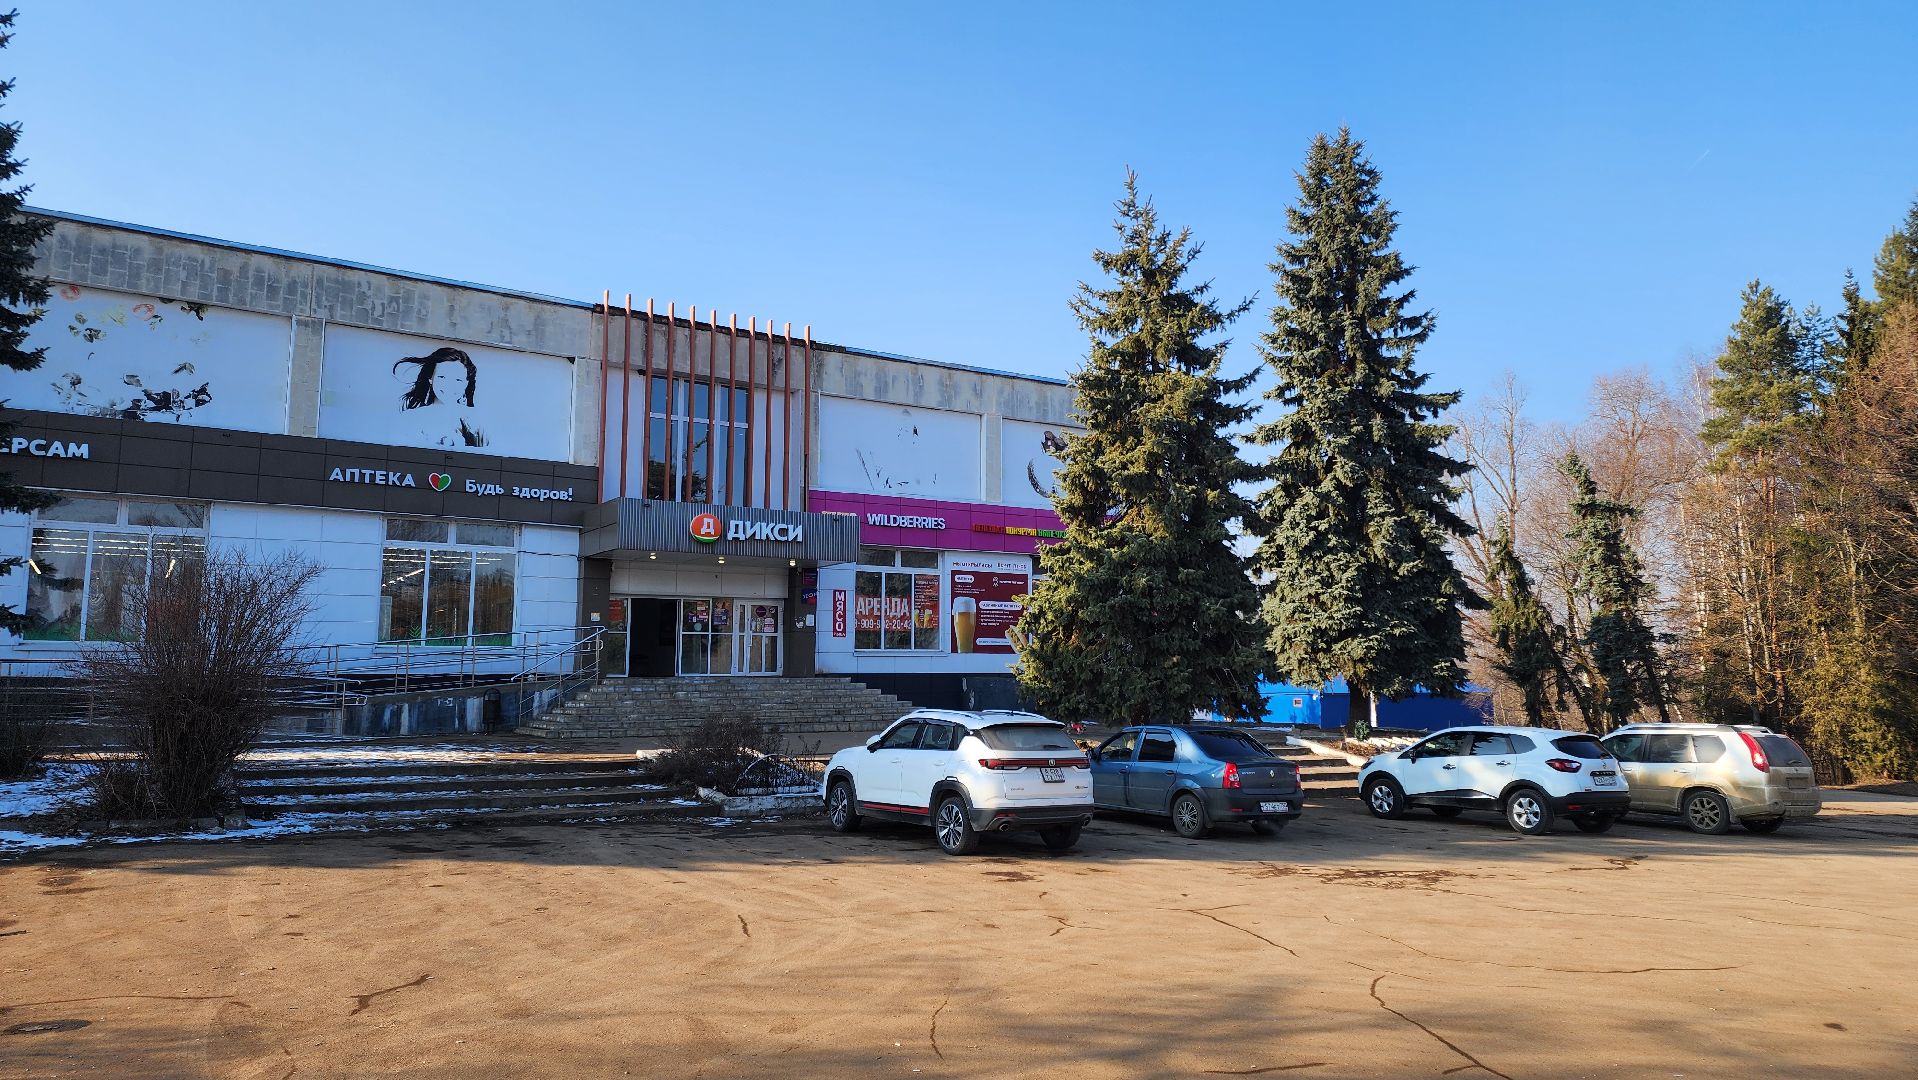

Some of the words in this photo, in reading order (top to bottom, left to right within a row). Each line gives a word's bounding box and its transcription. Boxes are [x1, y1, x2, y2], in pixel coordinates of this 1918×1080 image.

[328, 467, 416, 488] АПТЕКА
[465, 479, 504, 496] Будь
[511, 486, 573, 502] здоров!
[700, 517, 715, 535] Д
[727, 519, 802, 543] ДИКСИ
[866, 512, 946, 530] WILDBERRIES
[835, 591, 845, 632] МЯСО
[857, 597, 910, 618] АРЕНДА
